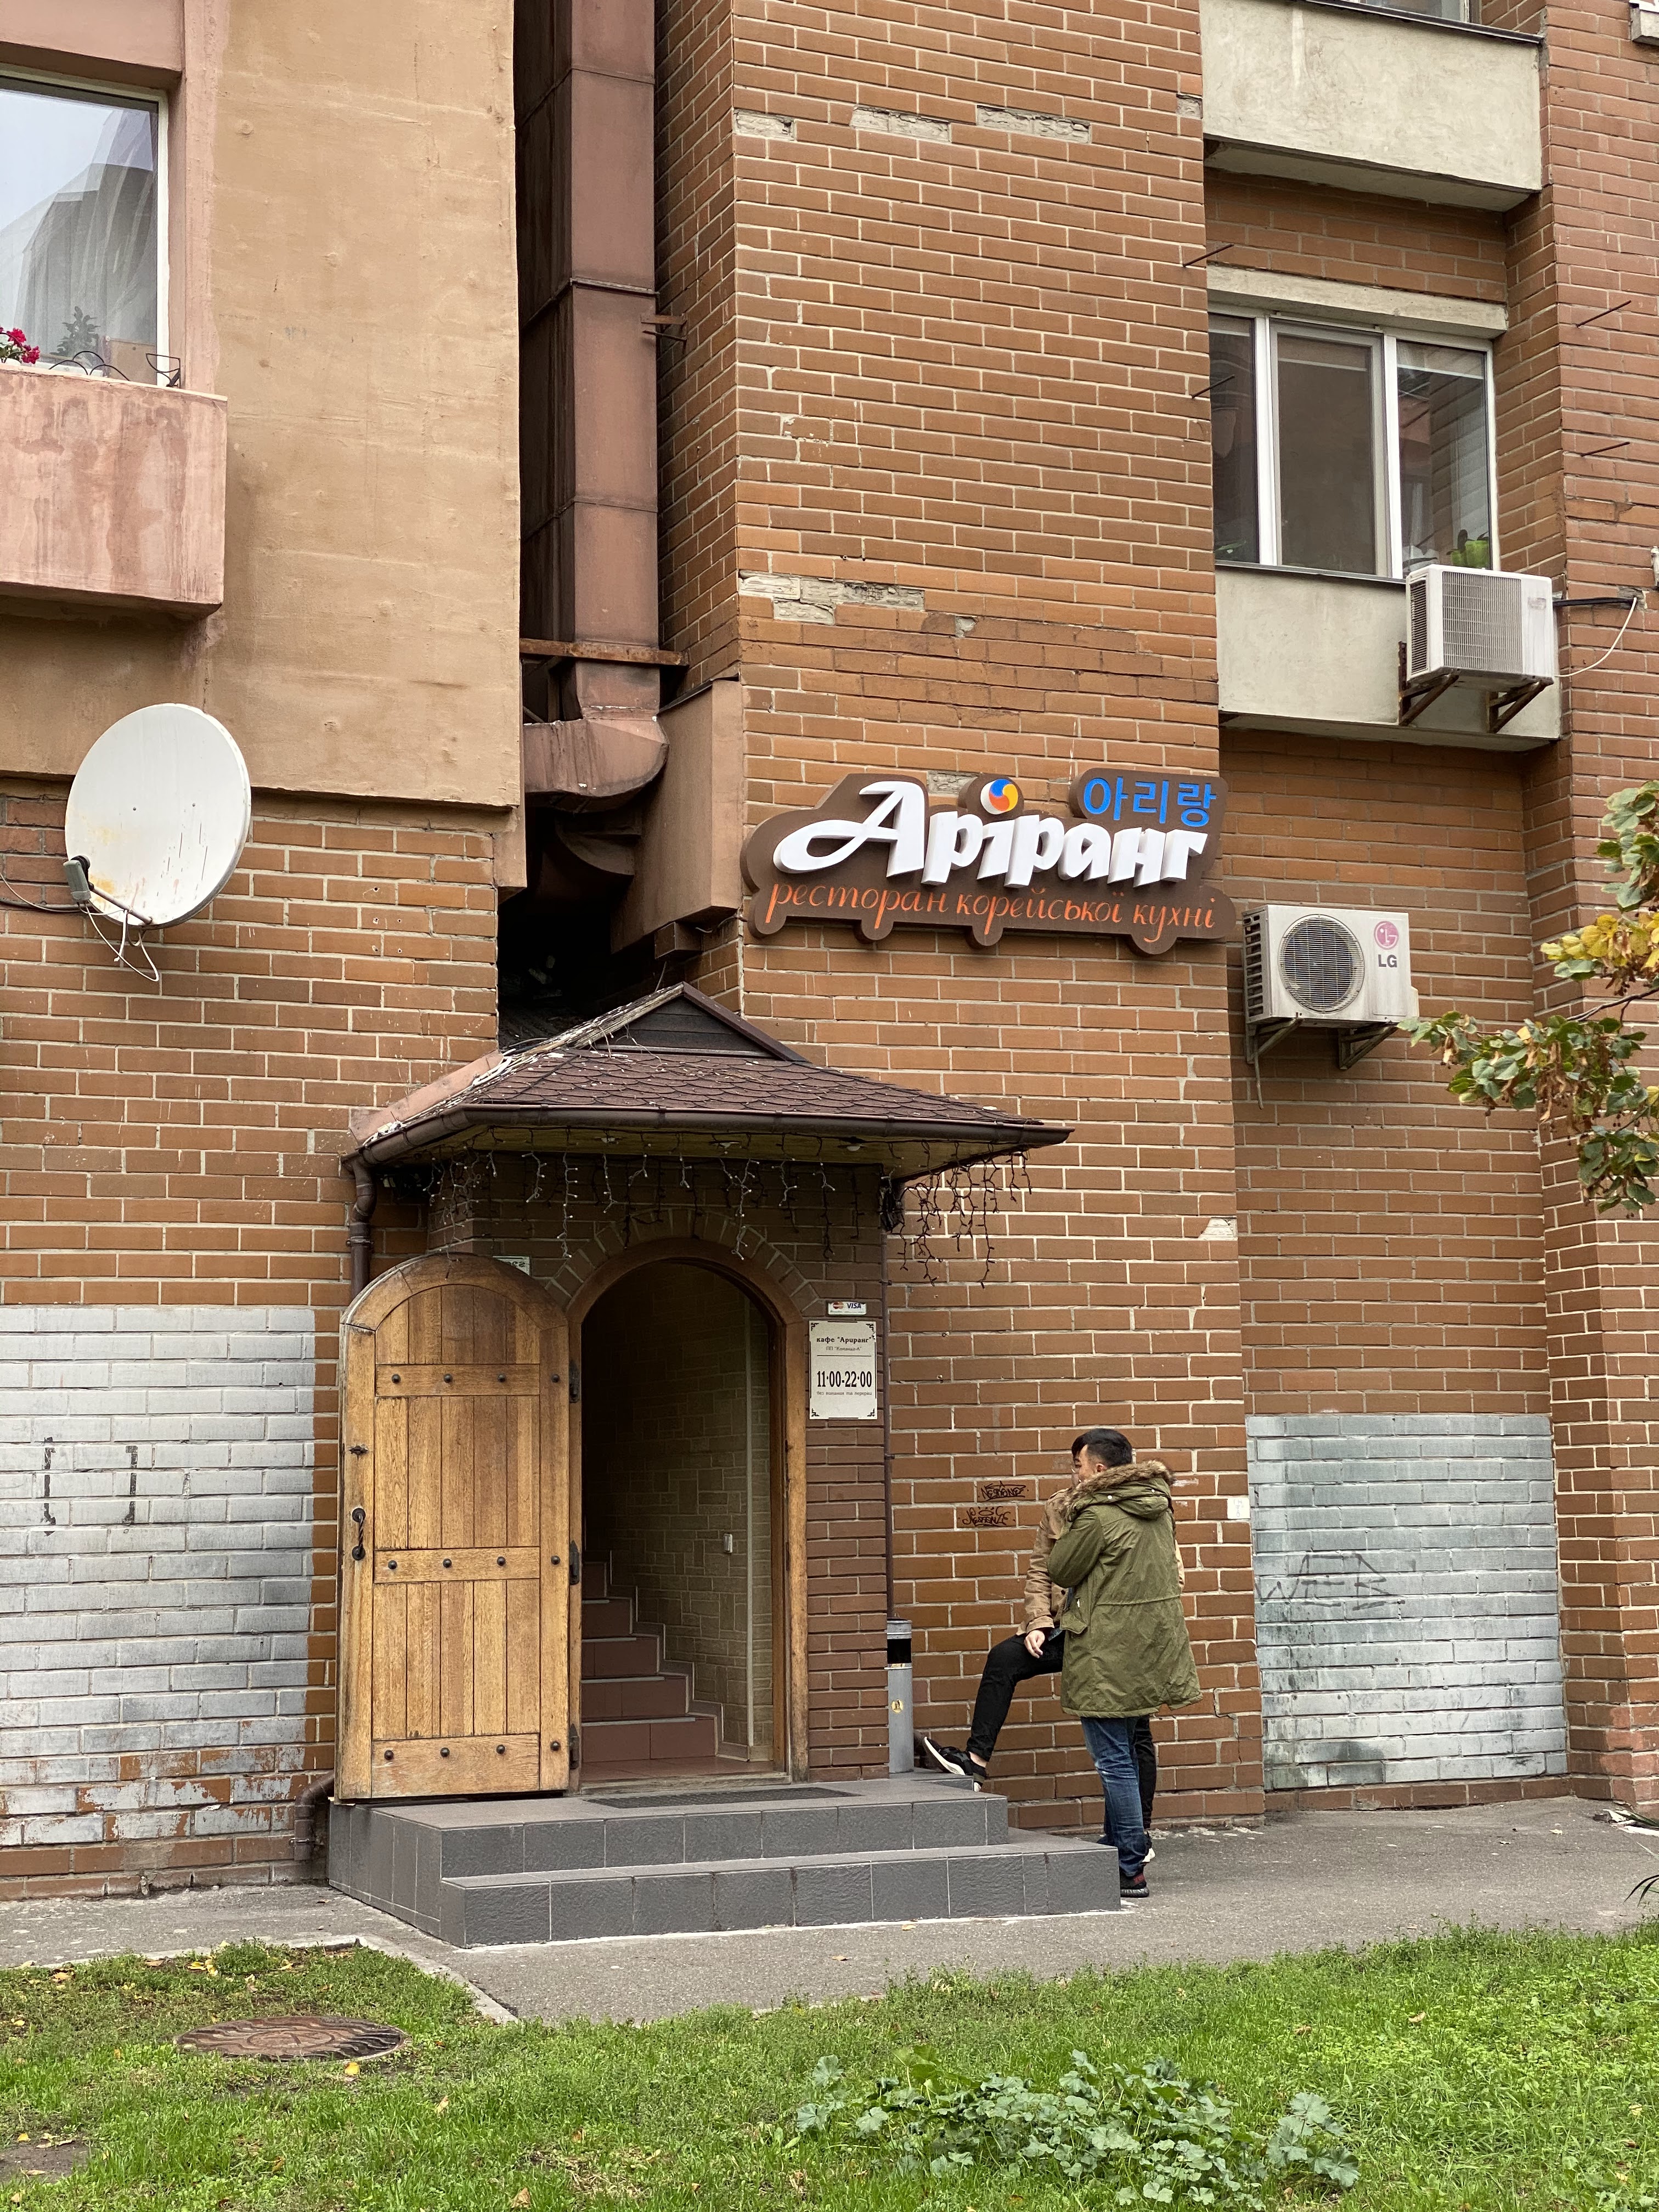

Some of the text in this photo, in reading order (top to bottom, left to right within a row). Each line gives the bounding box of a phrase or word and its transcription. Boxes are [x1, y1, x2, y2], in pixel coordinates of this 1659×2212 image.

[1084, 777, 1217, 827] 아리랑
[765, 883, 1215, 943] ресторан корейської кухні
[1378, 954, 1397, 968] LG
